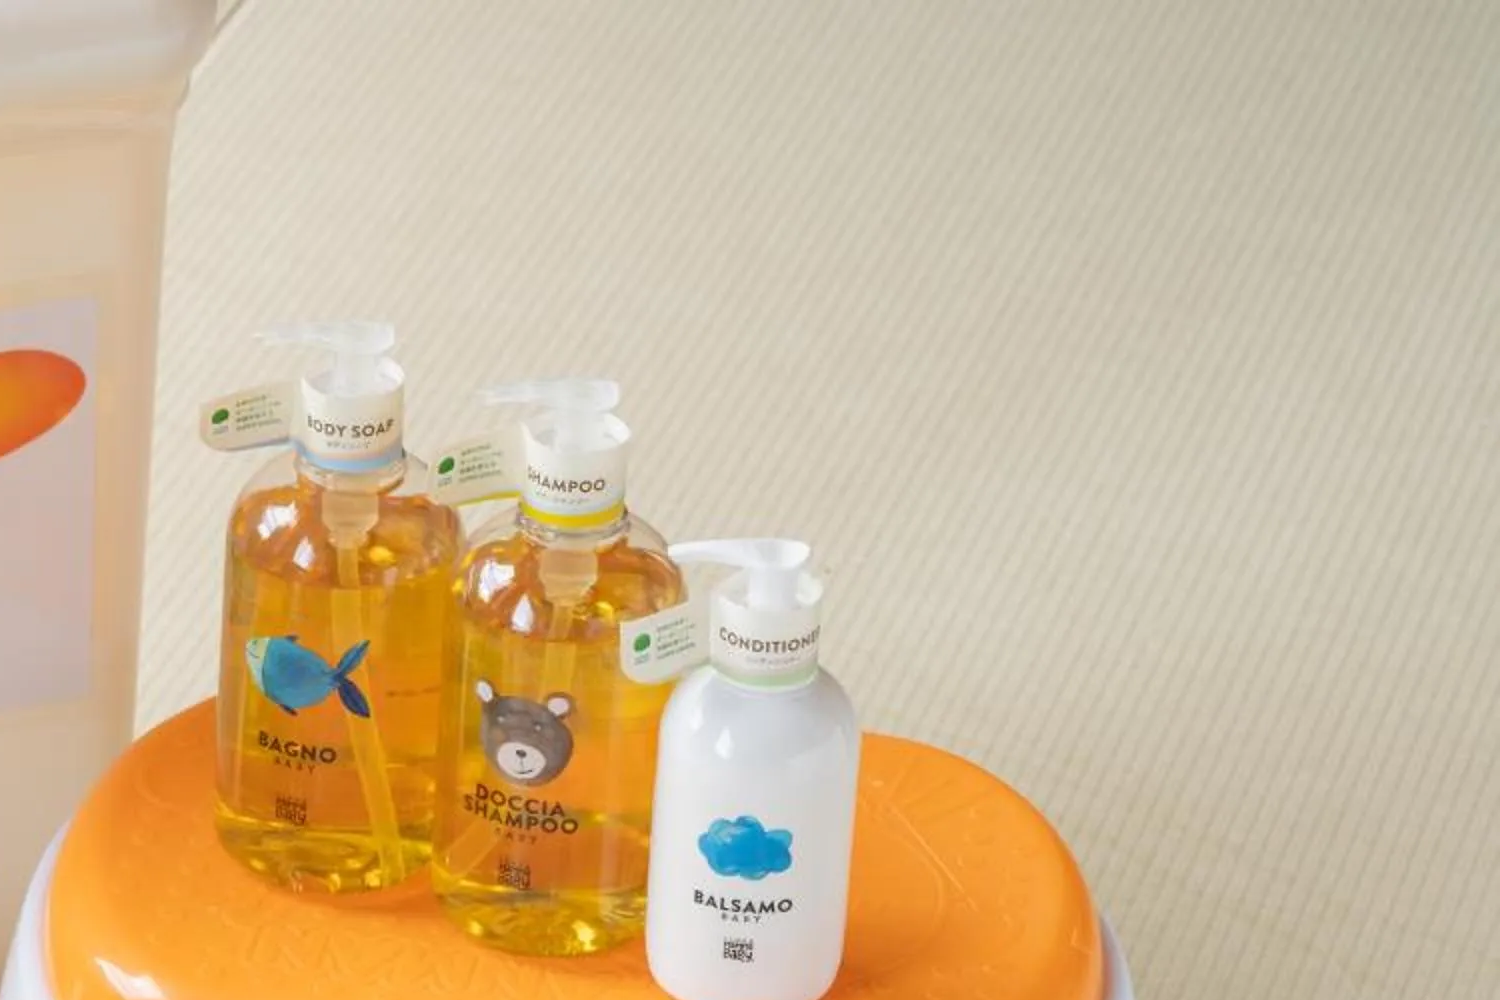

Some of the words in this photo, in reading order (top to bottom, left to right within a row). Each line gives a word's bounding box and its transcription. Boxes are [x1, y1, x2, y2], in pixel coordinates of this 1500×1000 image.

[259, 730, 337, 763] BAGNO
[463, 794, 578, 834] SHAMPOO
[476, 784, 565, 817] DOCCIA
[694, 889, 793, 913] BALSAMO
